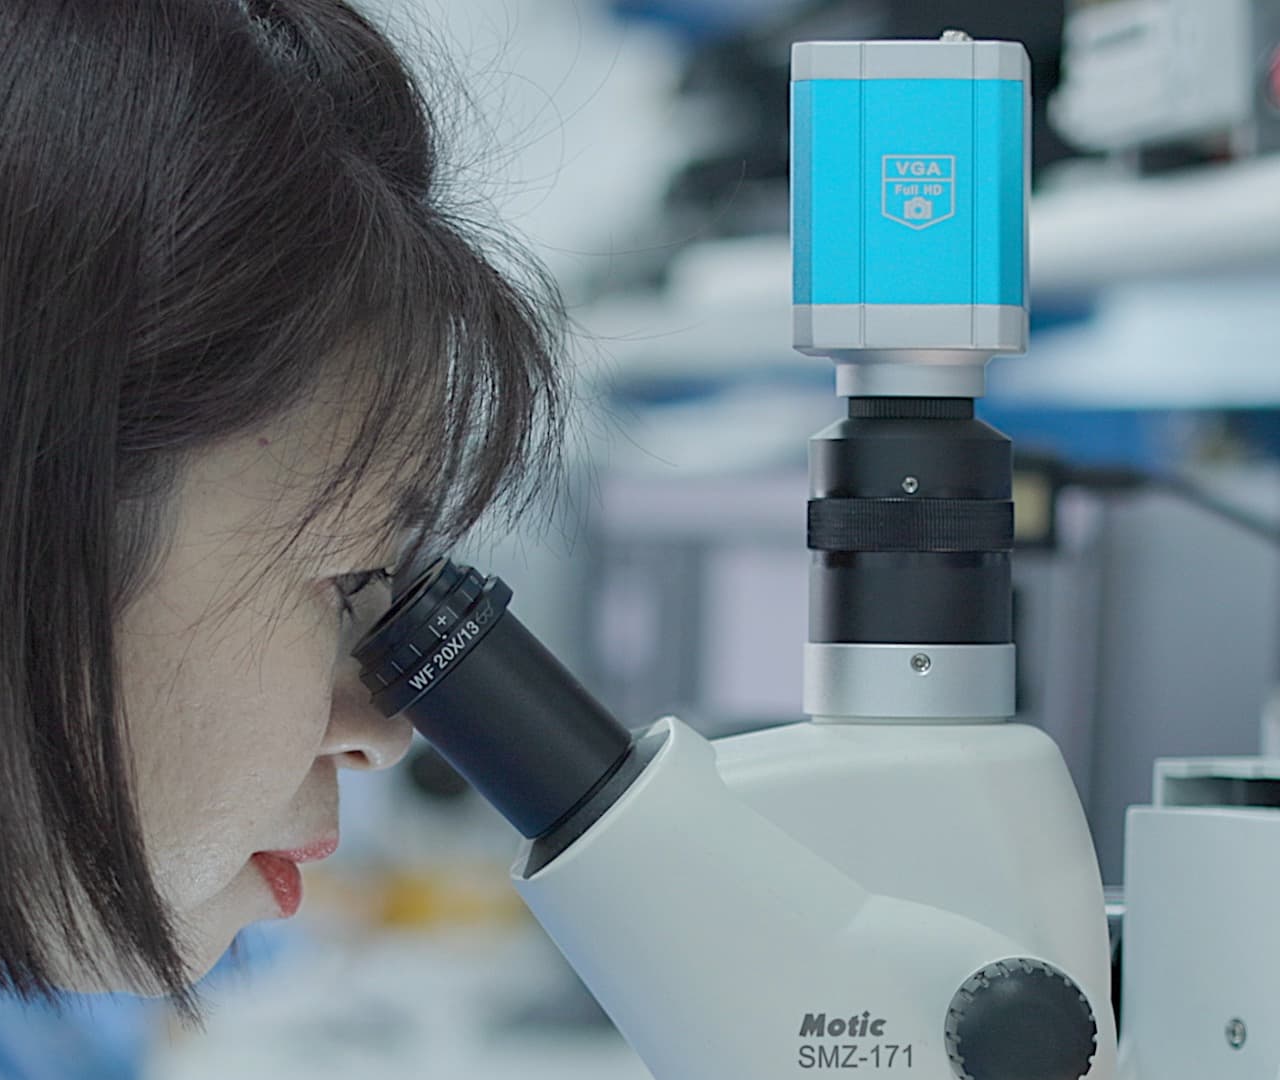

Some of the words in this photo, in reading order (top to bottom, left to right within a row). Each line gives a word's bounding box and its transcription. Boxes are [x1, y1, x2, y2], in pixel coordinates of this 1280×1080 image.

[895, 161, 942, 177] VGA
[895, 184, 919, 196] Full
[923, 184, 943, 196] HD
[408, 663, 436, 691] WF
[433, 620, 480, 670] 20X/13
[798, 1010, 887, 1038] Motic
[797, 1043, 913, 1070] SMZ-171
